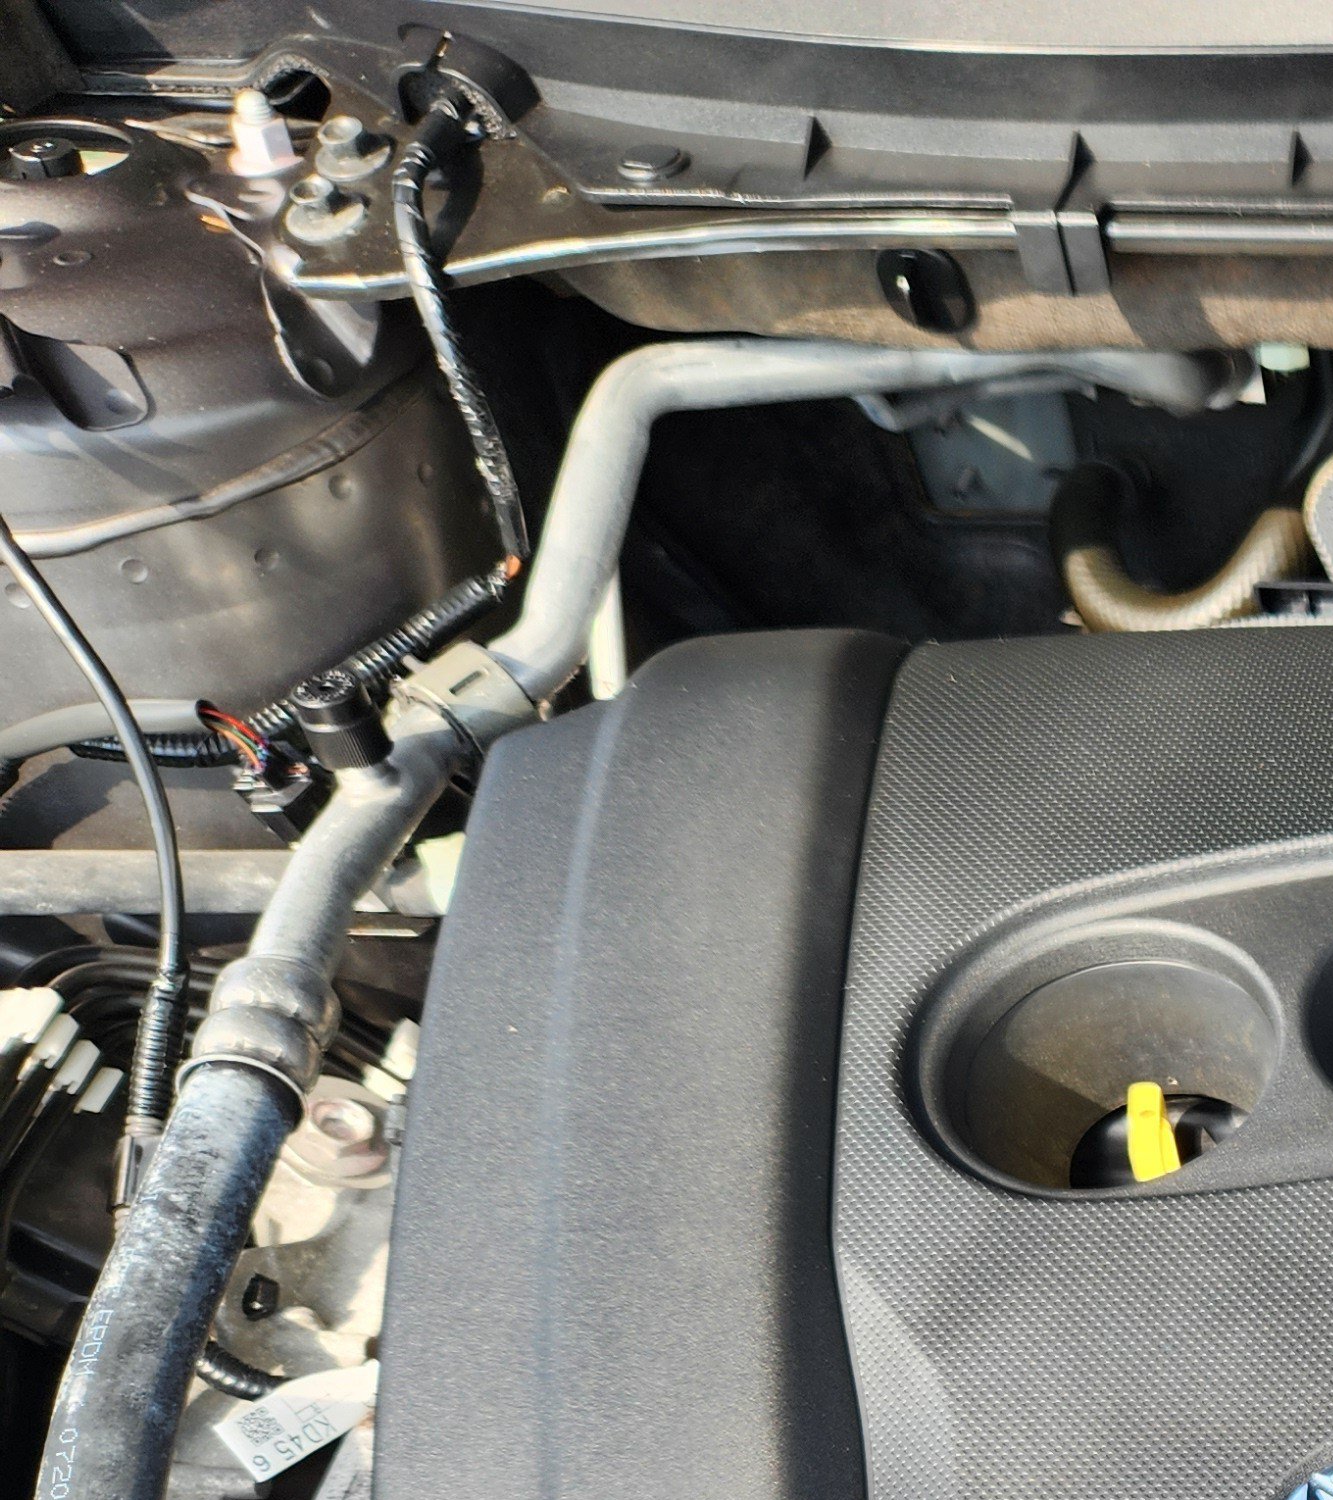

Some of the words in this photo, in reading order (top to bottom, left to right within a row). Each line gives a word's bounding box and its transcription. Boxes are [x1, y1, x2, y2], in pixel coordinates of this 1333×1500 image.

[75, 1309, 114, 1376] EPDM
[50, 1428, 78, 1500] 0720
[272, 1414, 337, 1462] KD45
